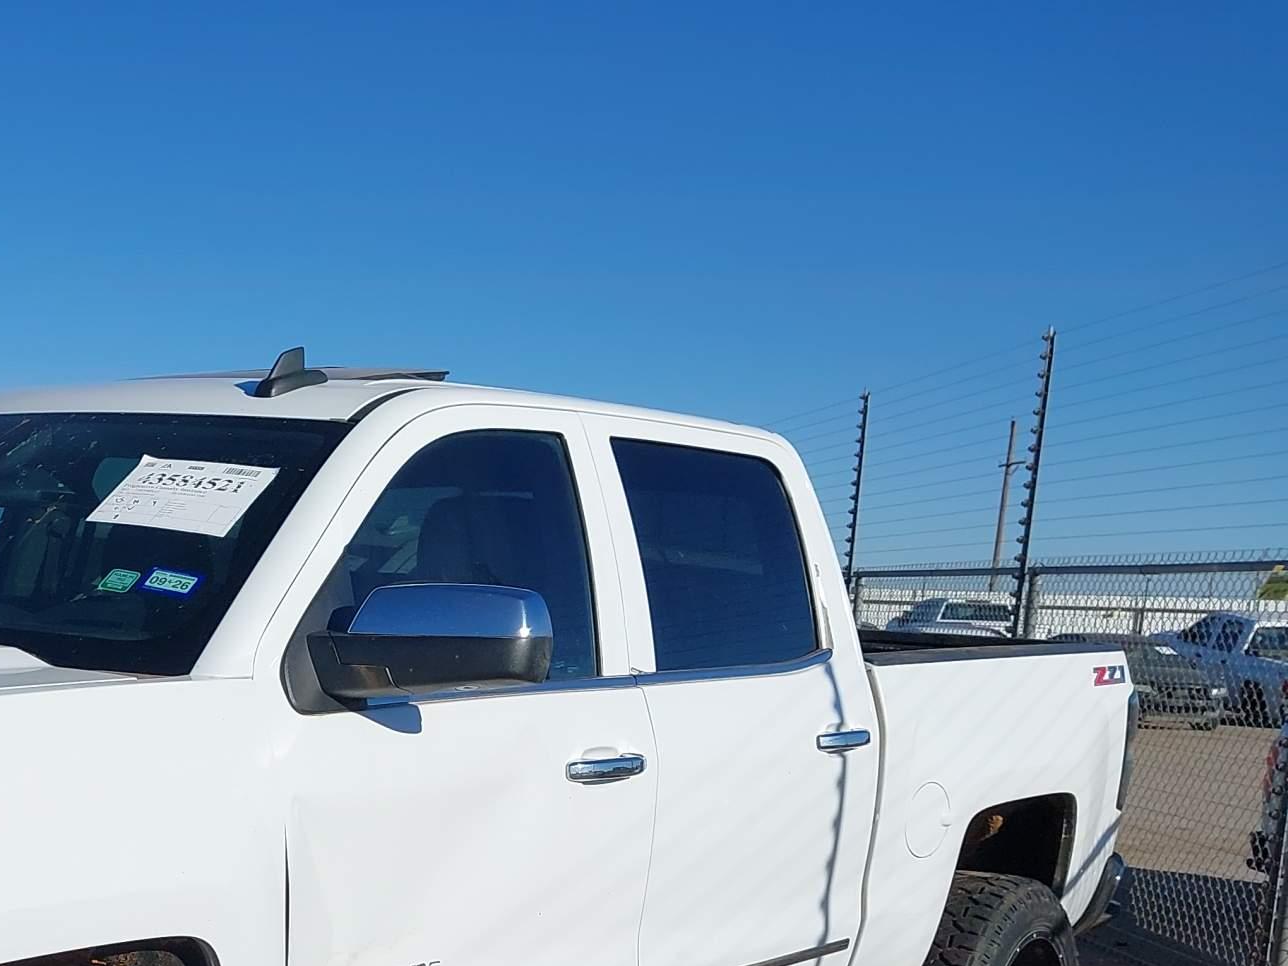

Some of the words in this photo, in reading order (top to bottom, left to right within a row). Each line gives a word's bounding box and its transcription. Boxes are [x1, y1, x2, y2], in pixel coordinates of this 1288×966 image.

[138, 472, 246, 494] 43584521
[149, 576, 167, 586] 09
[172, 580, 191, 591] 26
[1093, 665, 1126, 687] Z71
